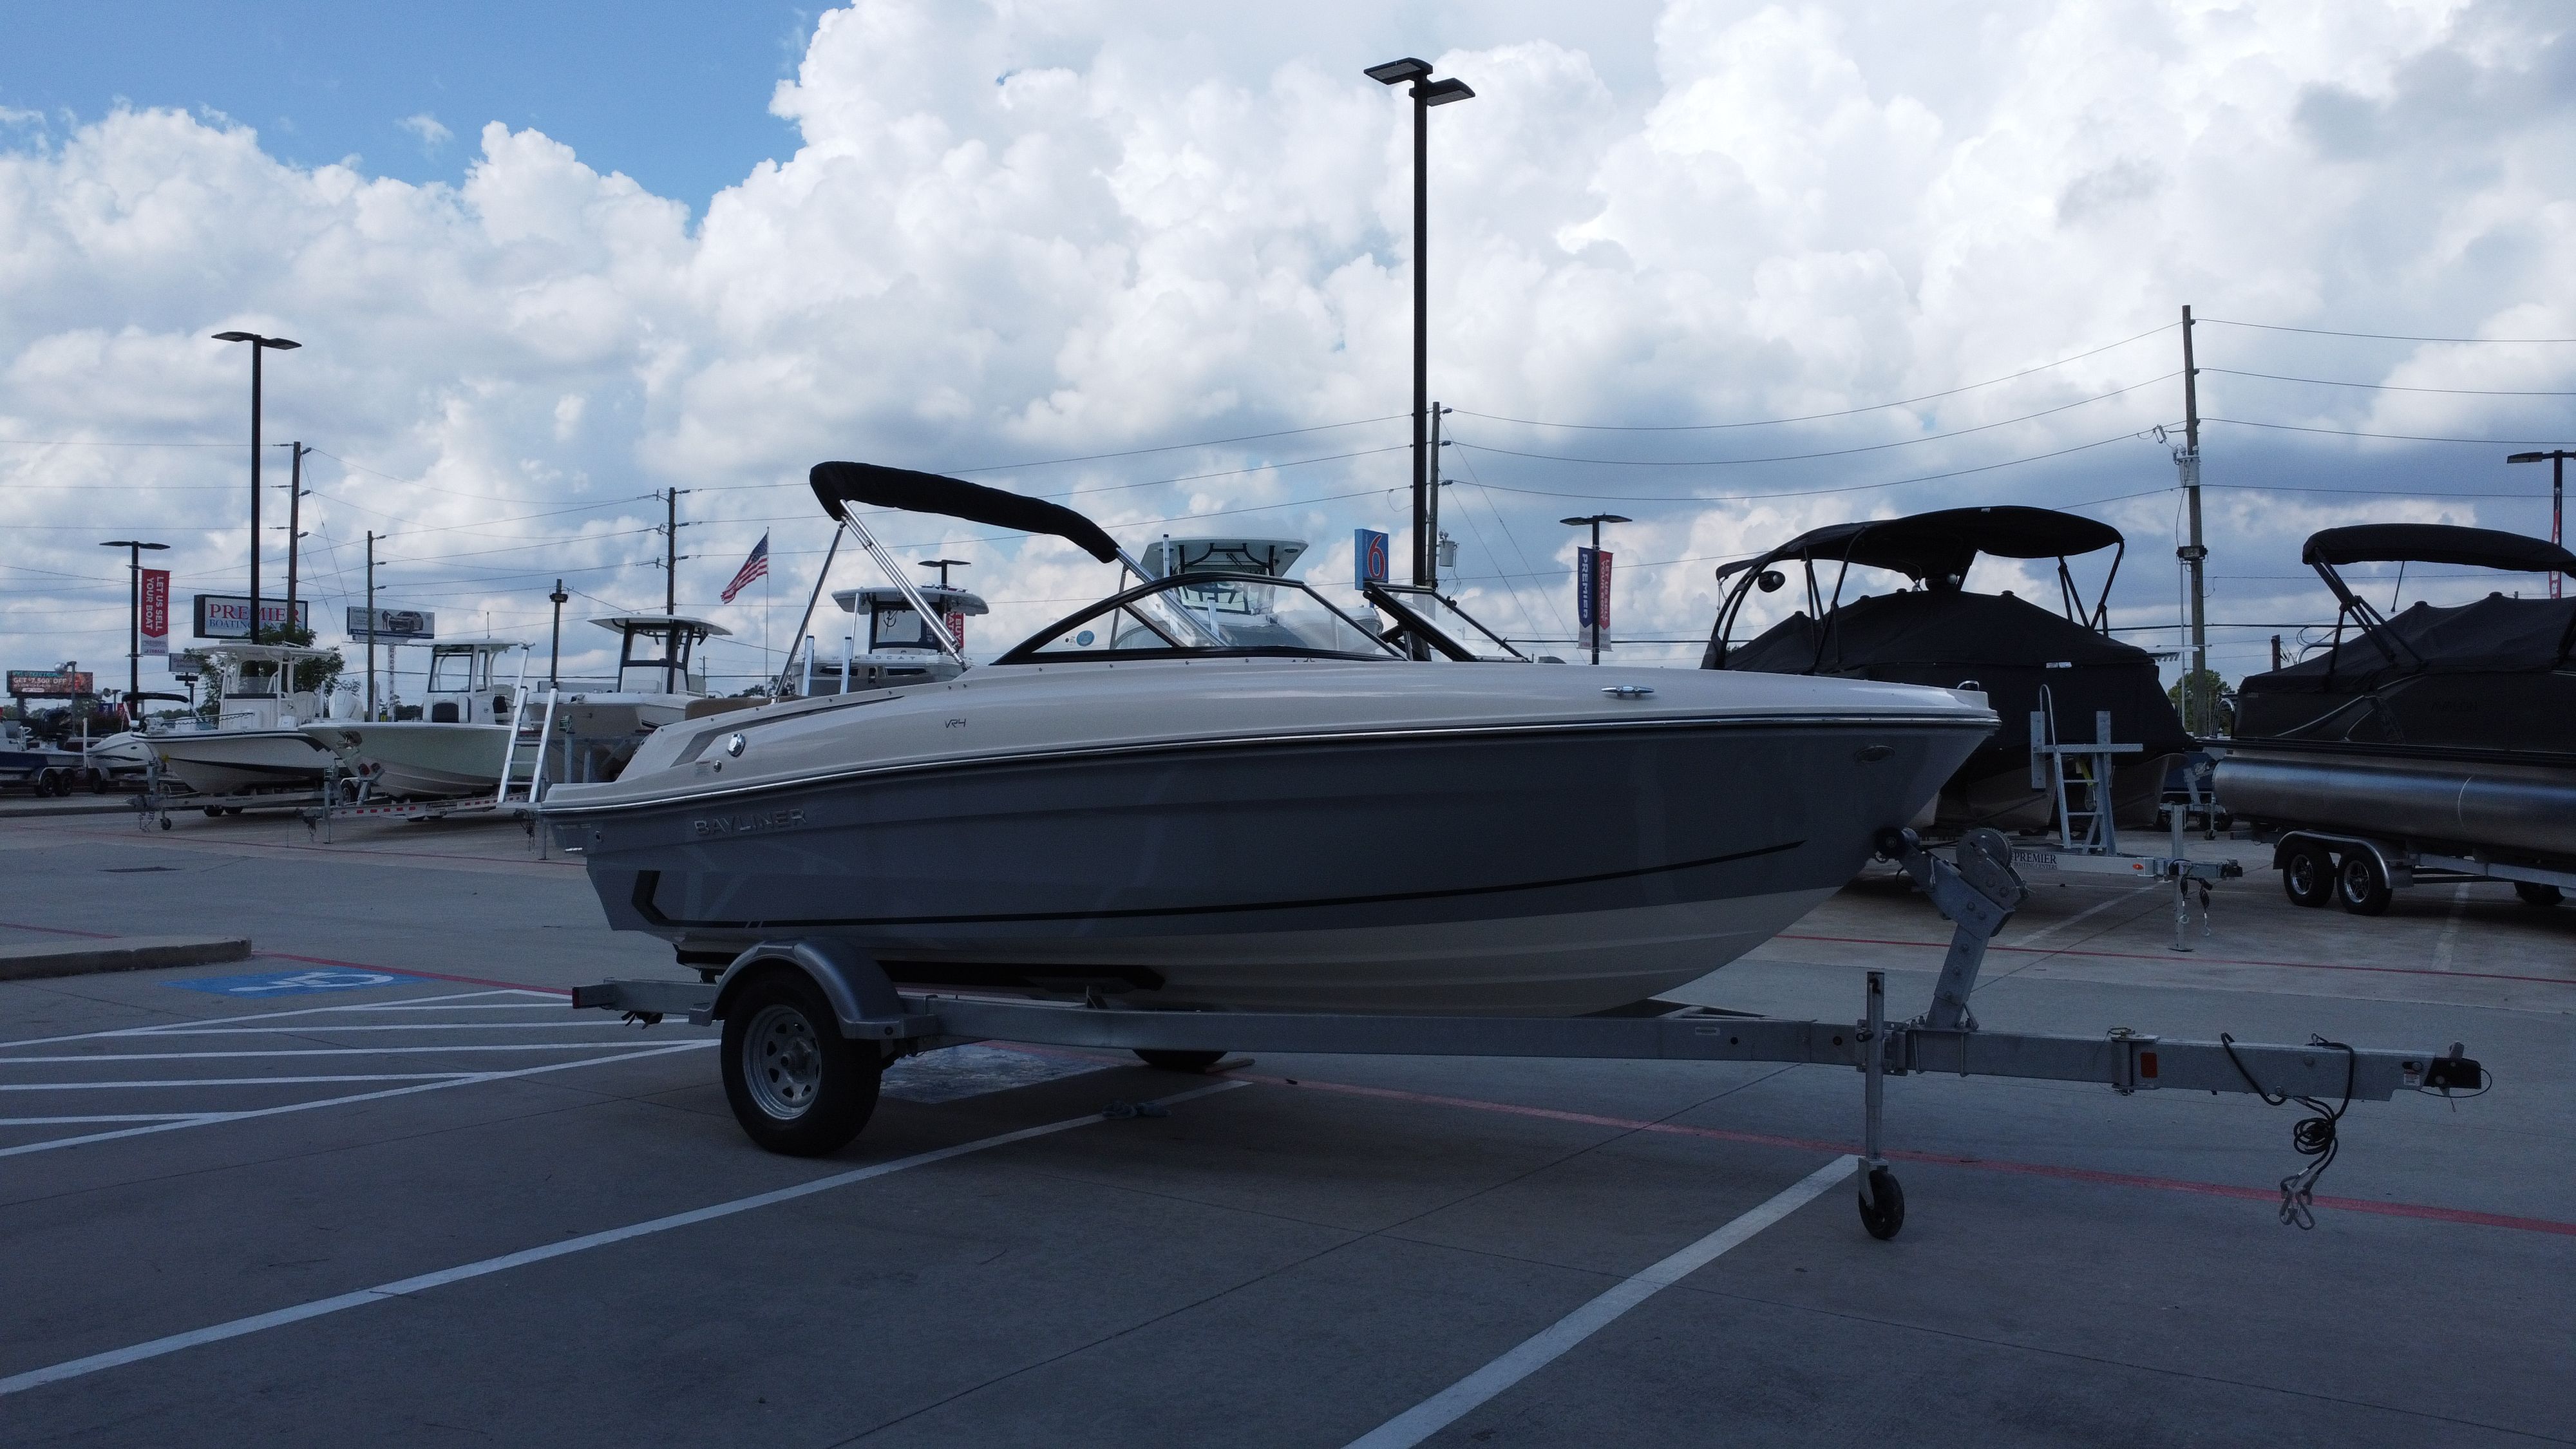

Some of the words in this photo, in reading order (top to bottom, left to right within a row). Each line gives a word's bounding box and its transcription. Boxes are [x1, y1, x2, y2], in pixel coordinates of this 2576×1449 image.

[1367, 534, 1385, 580] 6
[146, 577, 154, 603] YOUR
[156, 576, 164, 594] LET
[155, 594, 164, 608] US
[146, 605, 154, 630] BOAT
[155, 609, 164, 632] SELL
[944, 718, 966, 728] VR4
[694, 808, 807, 835] BAYLINER
[2014, 851, 2058, 864] PREMIER
